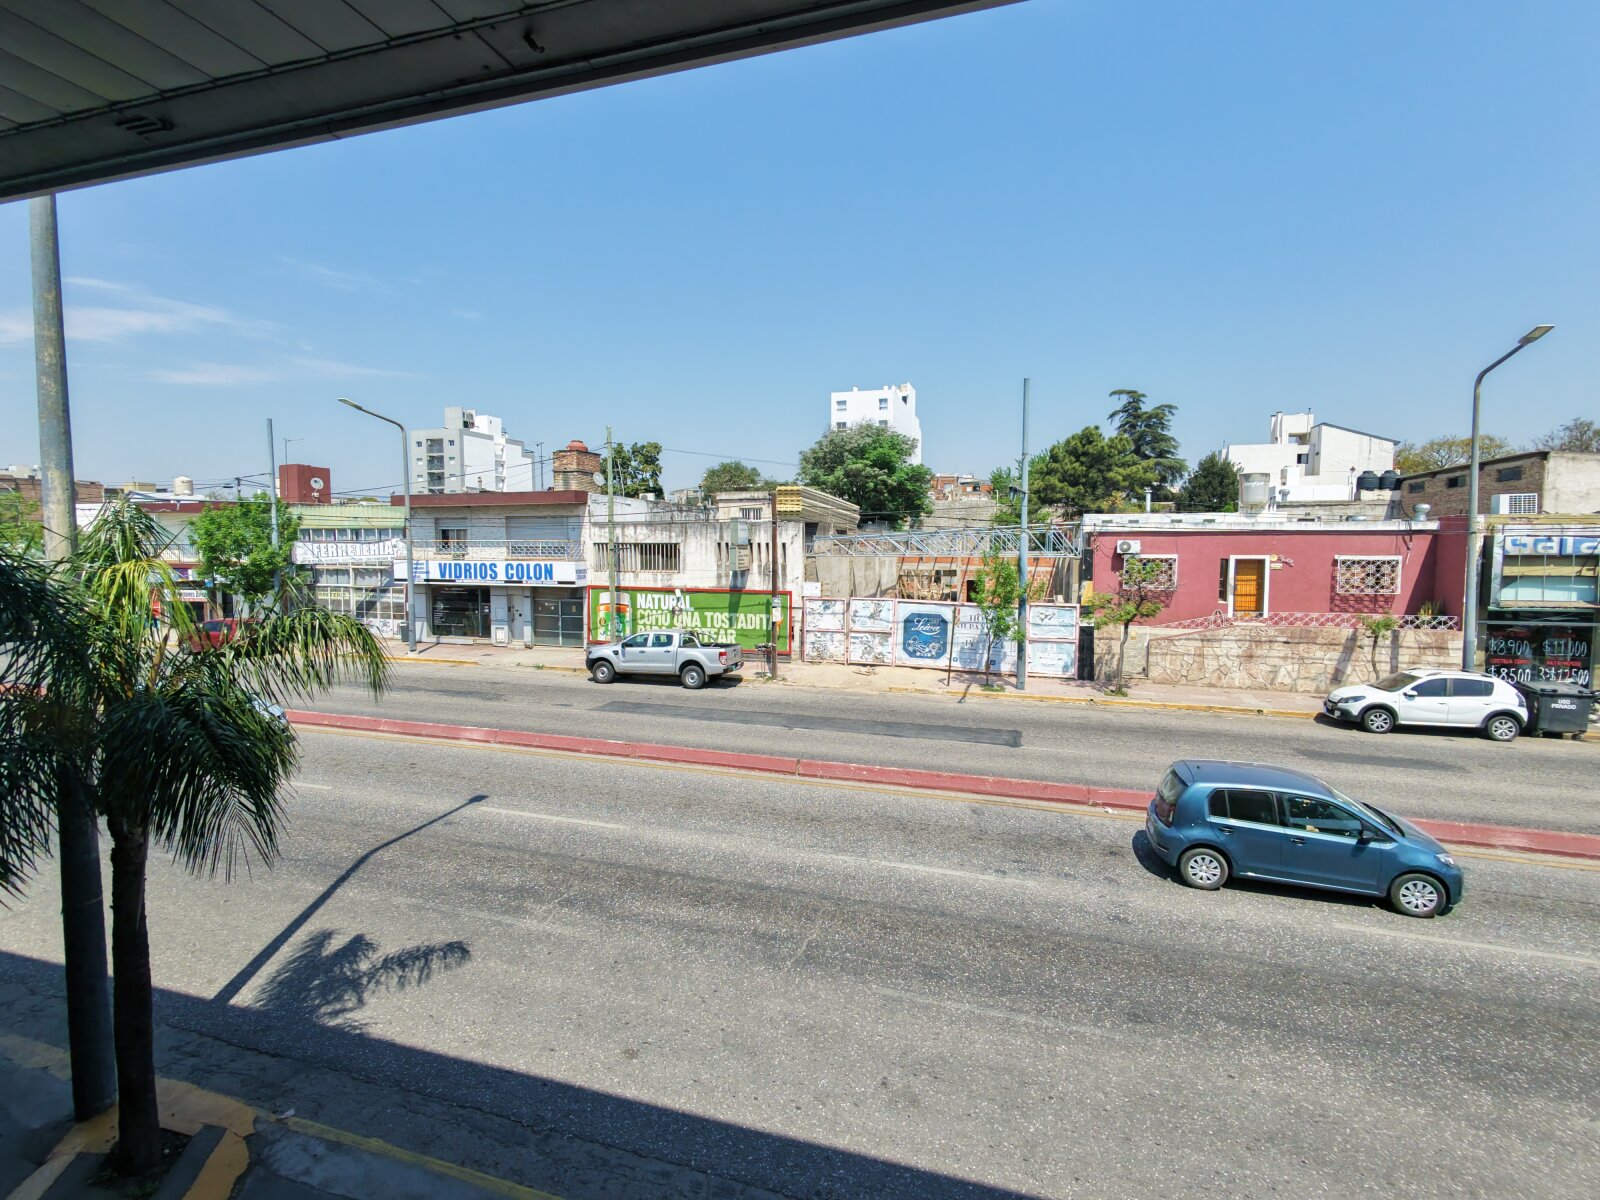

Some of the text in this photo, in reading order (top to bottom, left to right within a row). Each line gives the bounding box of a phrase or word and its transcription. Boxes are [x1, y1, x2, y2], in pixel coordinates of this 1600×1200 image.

[438, 562, 498, 580] VIDRIOS
[504, 563, 553, 581] COLON
[636, 608, 670, 626] COMO
